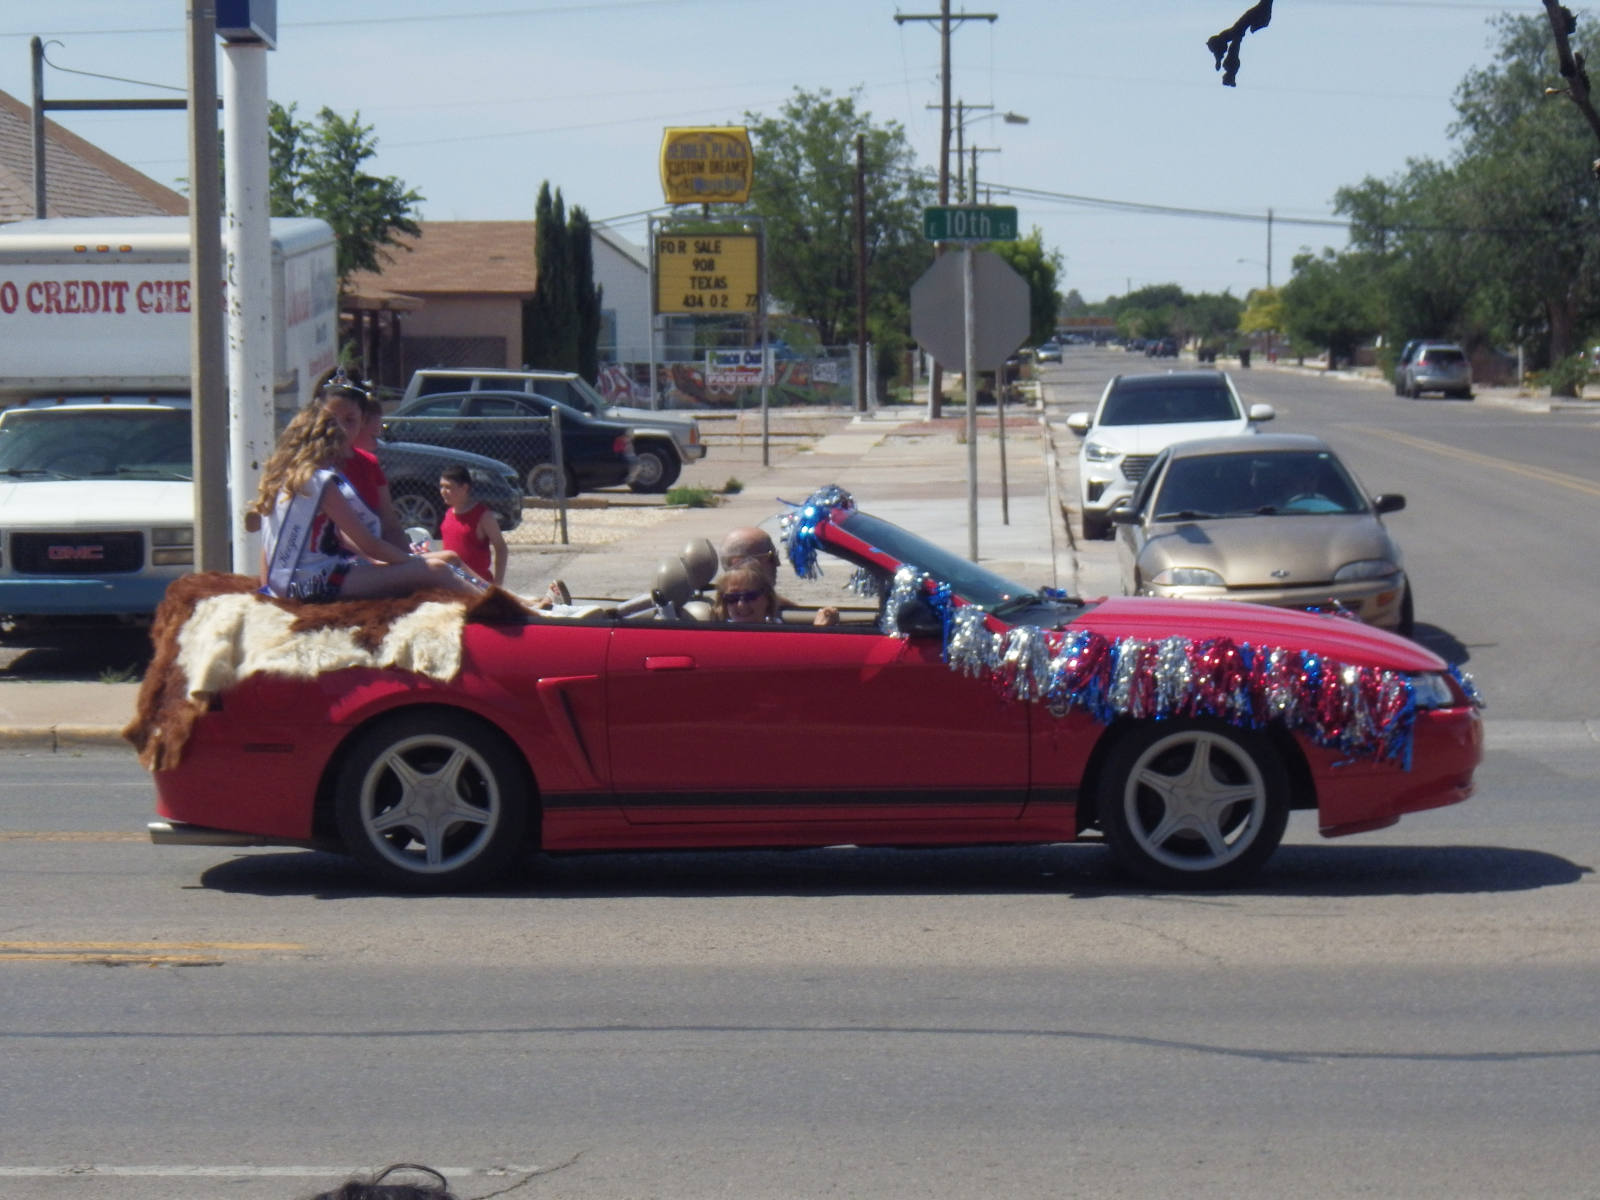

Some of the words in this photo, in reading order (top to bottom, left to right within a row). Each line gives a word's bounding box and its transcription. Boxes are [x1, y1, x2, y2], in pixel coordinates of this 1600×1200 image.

[945, 210, 991, 236] 10th
[660, 241, 686, 254] FOR
[694, 241, 722, 254] SALE
[690, 276, 728, 290] TEXAS
[26, 280, 130, 314] CREDIT
[136, 280, 228, 314] CHE
[48, 545, 104, 560] GMC
